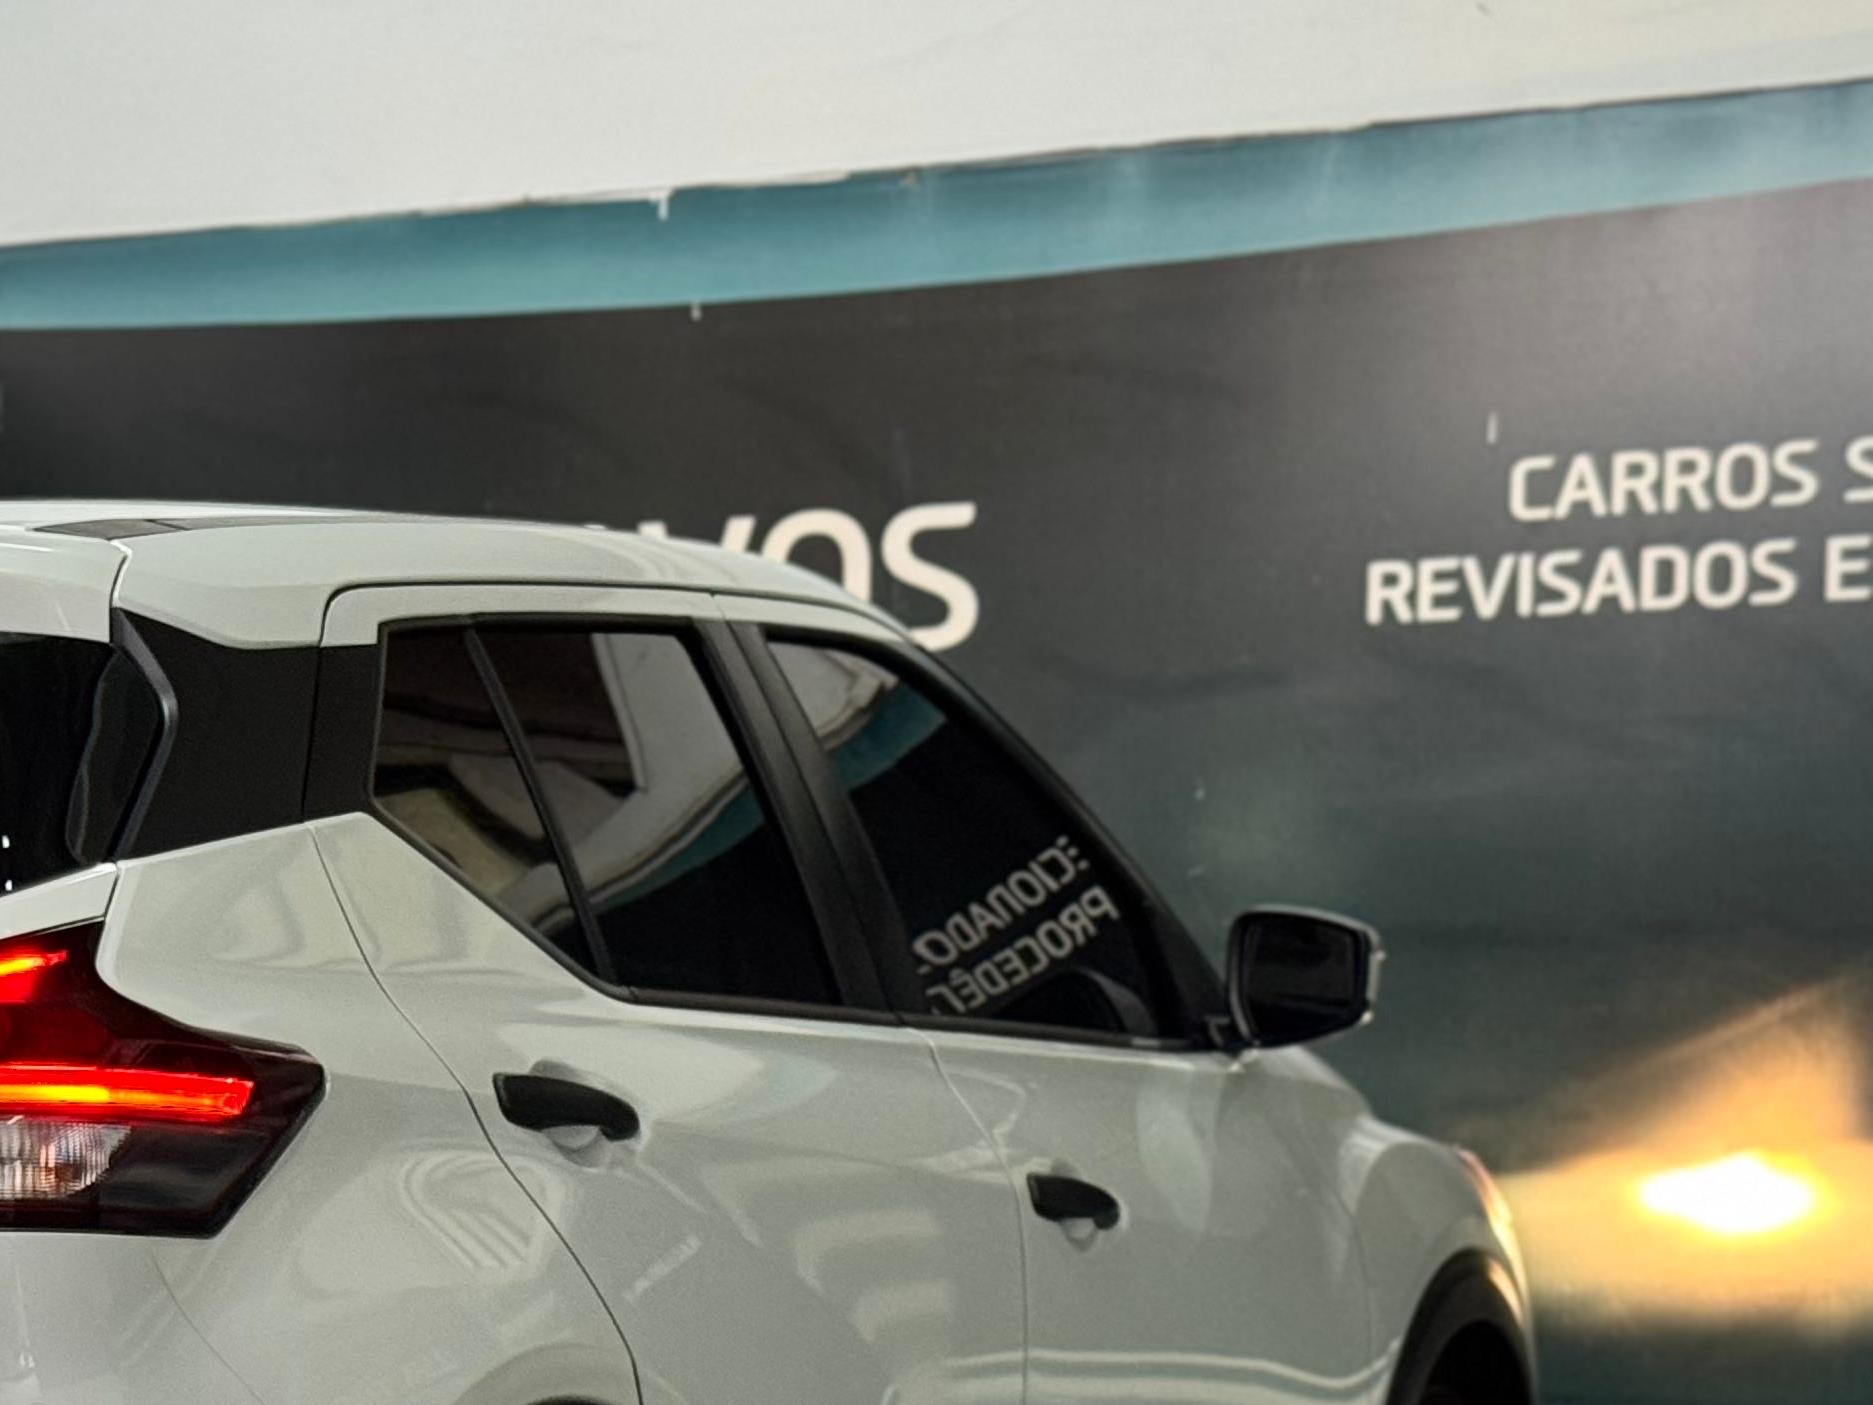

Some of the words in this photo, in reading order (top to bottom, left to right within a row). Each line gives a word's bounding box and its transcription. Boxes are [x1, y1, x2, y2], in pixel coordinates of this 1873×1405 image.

[1509, 439, 1818, 521] CARROS
[1364, 538, 1797, 624] REVISADOS
[1825, 533, 1872, 601] E
